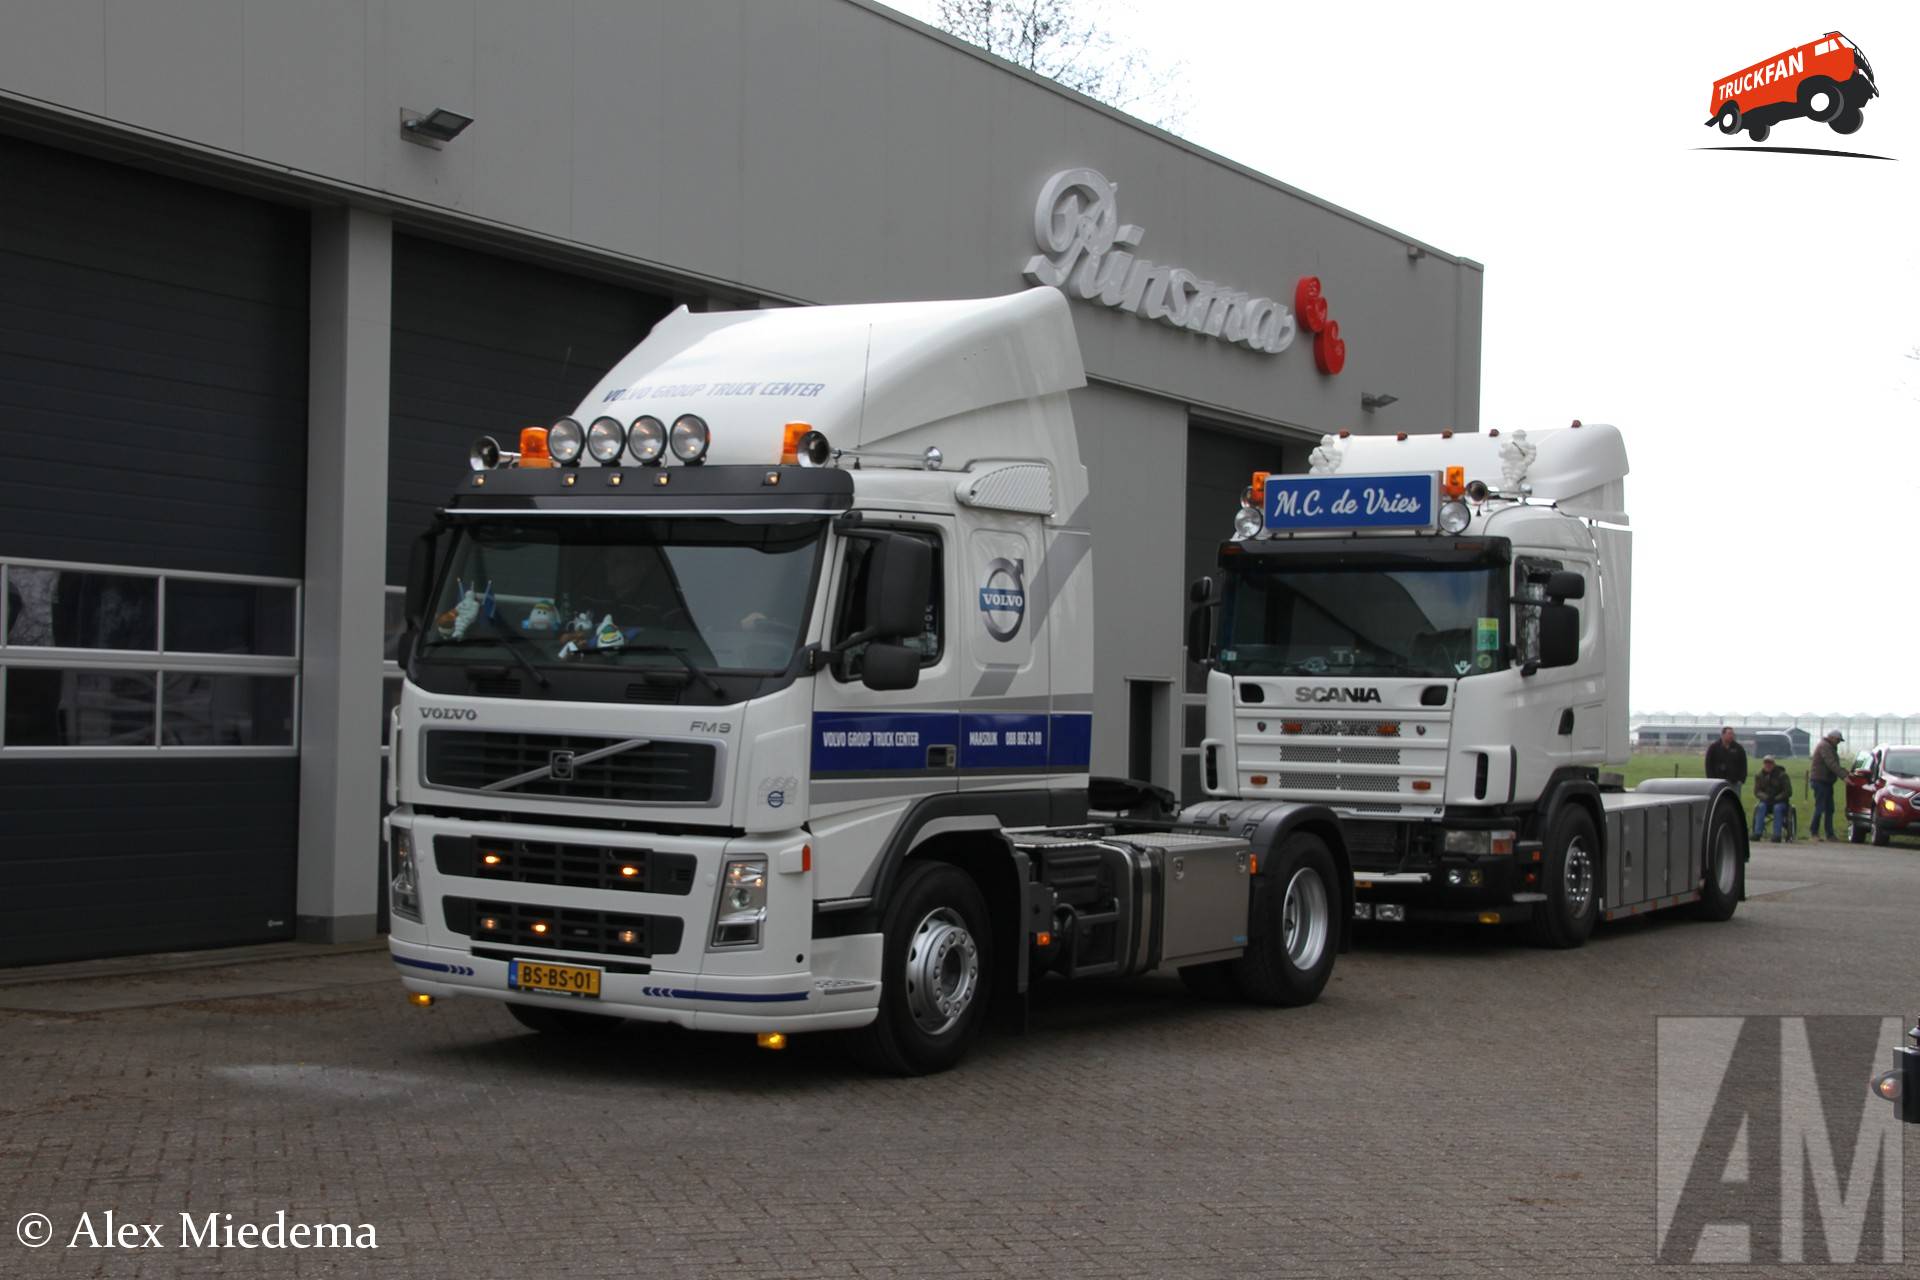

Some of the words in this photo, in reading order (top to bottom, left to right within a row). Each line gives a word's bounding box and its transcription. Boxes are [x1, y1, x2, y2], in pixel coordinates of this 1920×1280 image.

[602, 387, 648, 402] VOLVO
[651, 384, 704, 399] GROUP
[706, 382, 759, 397] TRUCK
[760, 382, 825, 397] CENTER
[1274, 489, 1324, 517] M.C.
[1331, 488, 1358, 514] de
[1363, 487, 1421, 516] Vries
[982, 593, 1023, 607] VOLVO
[1295, 686, 1382, 703] SCANIA
[419, 707, 477, 720] VOLVO
[690, 721, 731, 733] FM9
[823, 731, 847, 747] VOLVO
[847, 731, 871, 747] GROUP
[872, 731, 895, 747] TRUCK
[895, 731, 920, 747] CENTER
[522, 965, 592, 990] BS-BS-01
